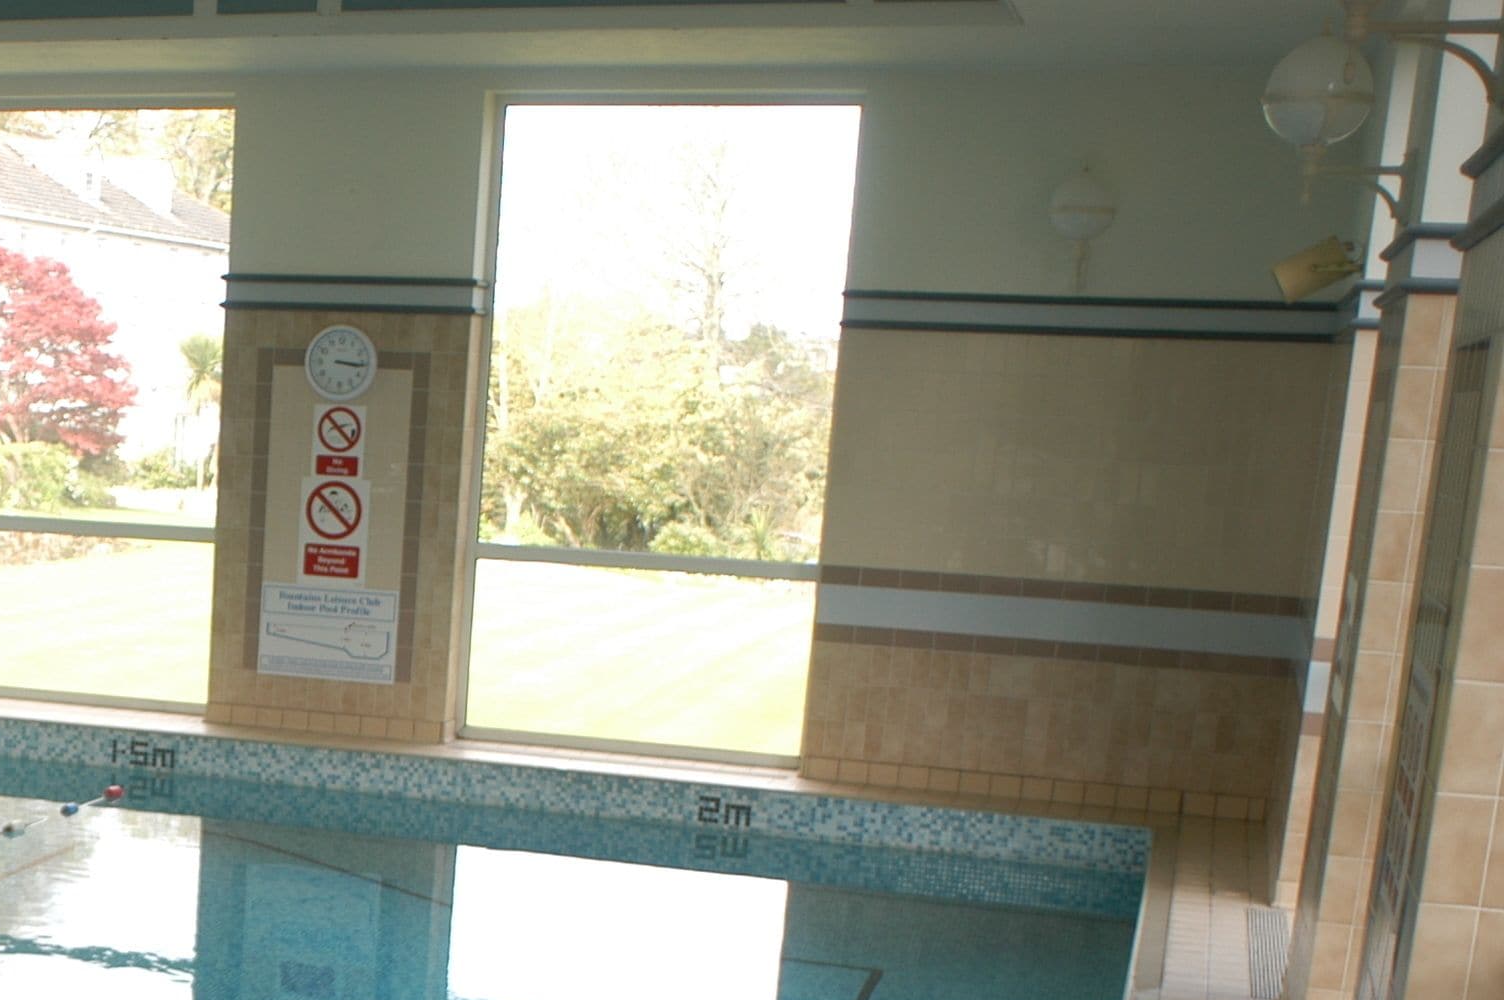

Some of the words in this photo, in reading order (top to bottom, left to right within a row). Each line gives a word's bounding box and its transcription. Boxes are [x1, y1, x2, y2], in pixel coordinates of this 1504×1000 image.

[324, 593, 357, 604] Leisure
[359, 596, 381, 607] Club
[288, 601, 316, 610] Indoor
[319, 603, 338, 613] Pool
[341, 605, 370, 616] Profile
[698, 795, 752, 827] 2m
